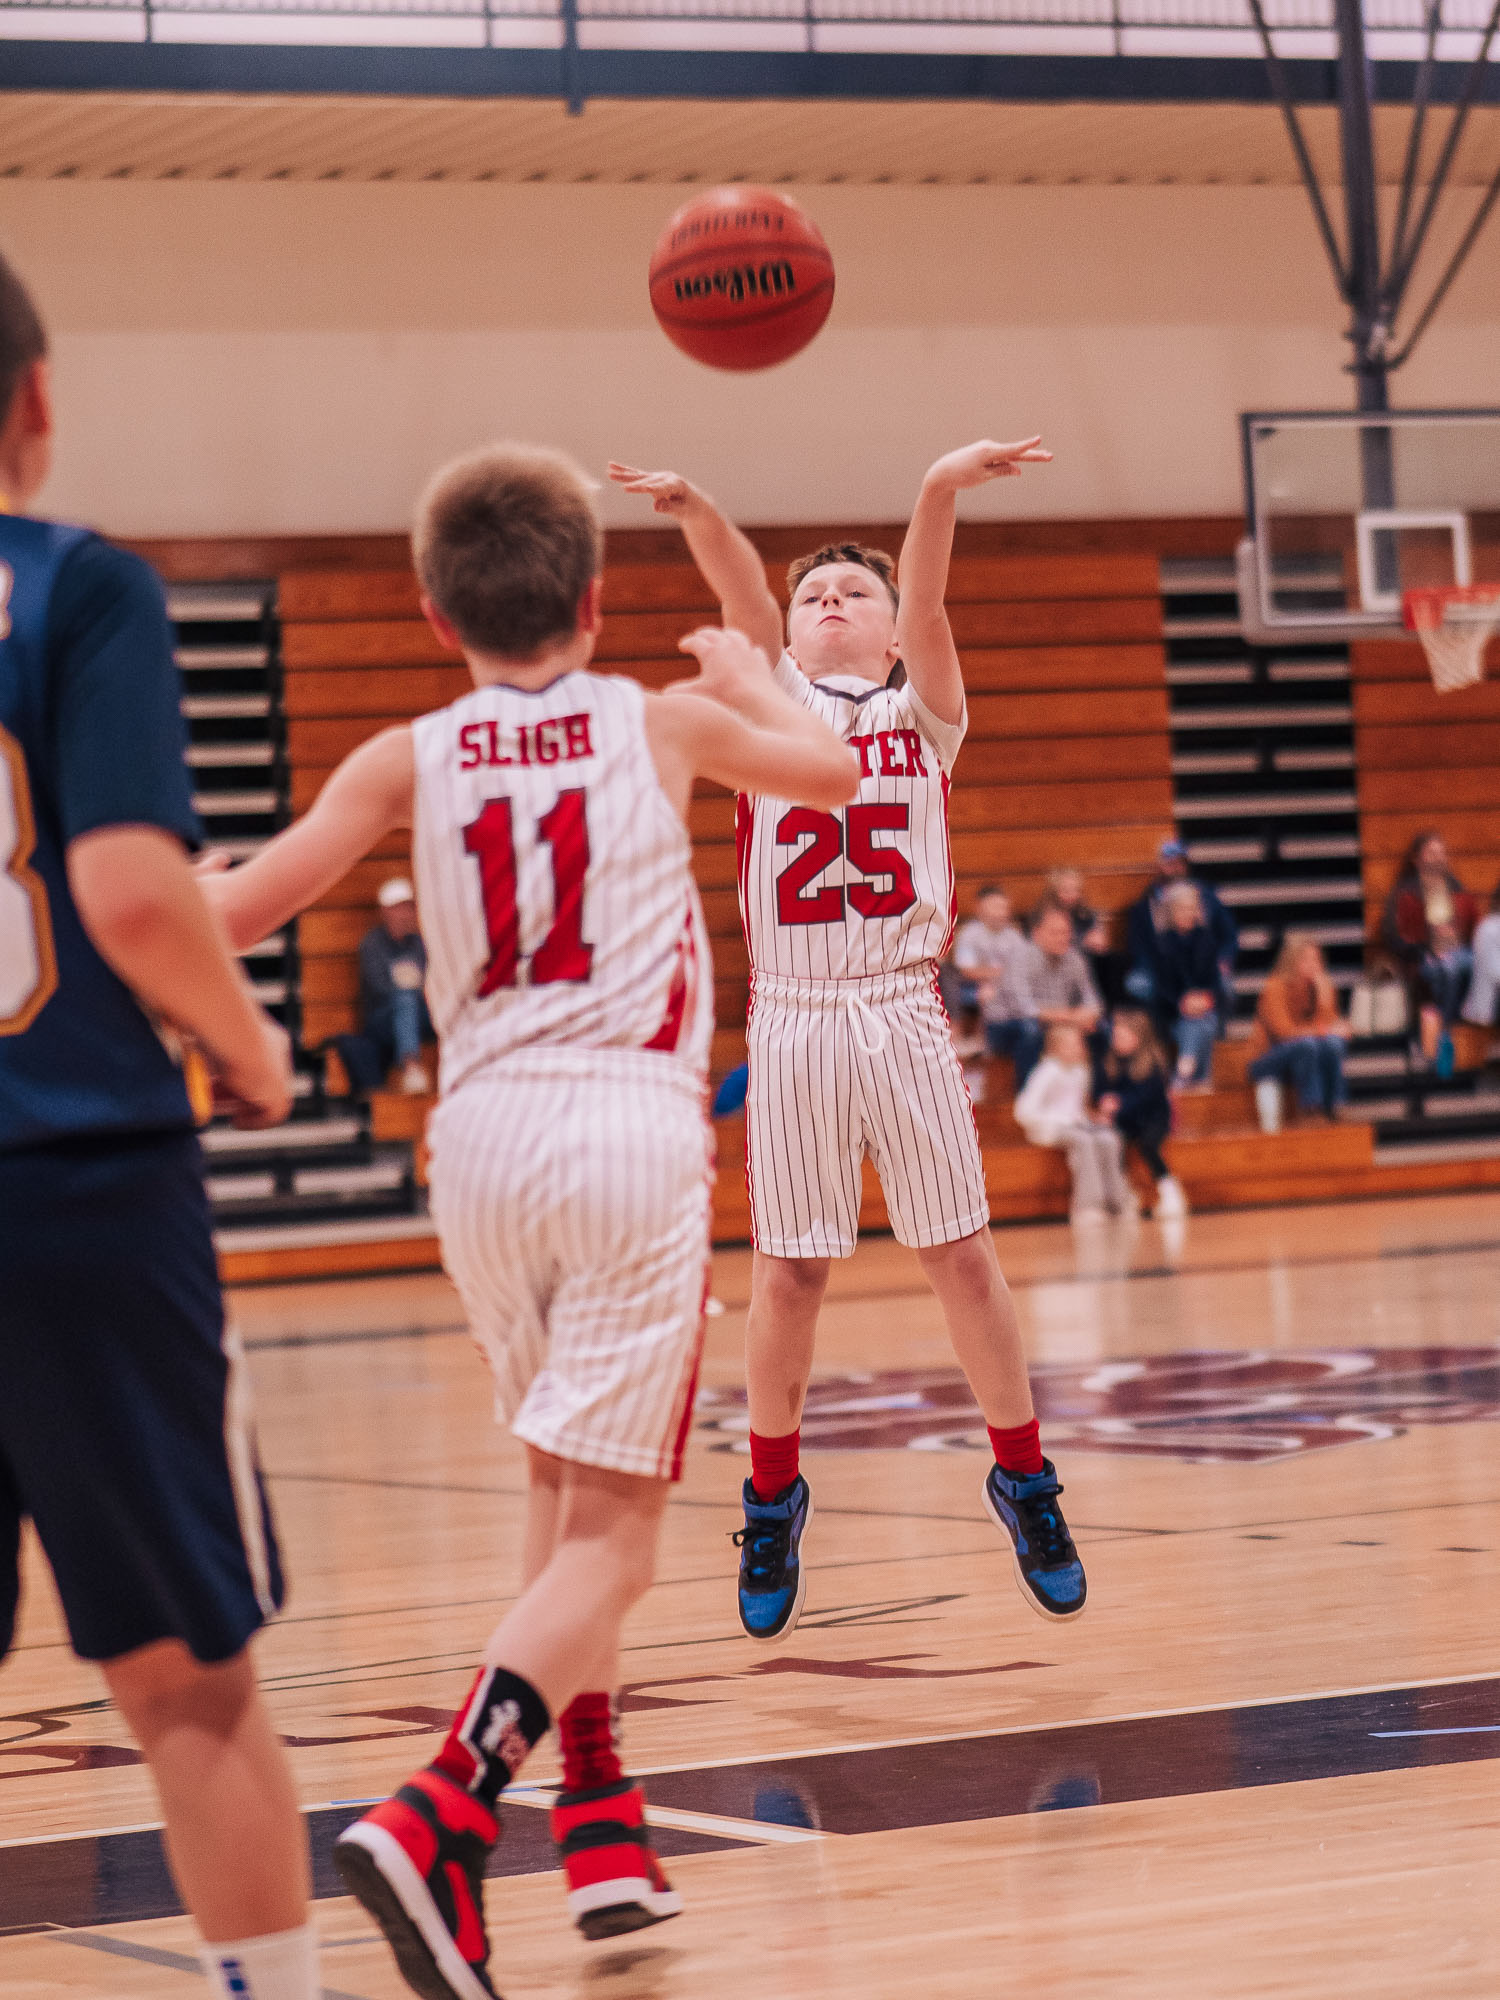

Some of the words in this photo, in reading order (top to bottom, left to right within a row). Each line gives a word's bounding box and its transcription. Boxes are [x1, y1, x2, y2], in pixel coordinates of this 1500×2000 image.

[459, 713, 595, 771] SLIGH
[846, 729, 929, 778] TER
[461, 786, 596, 1000] 11
[776, 803, 918, 926] 25
